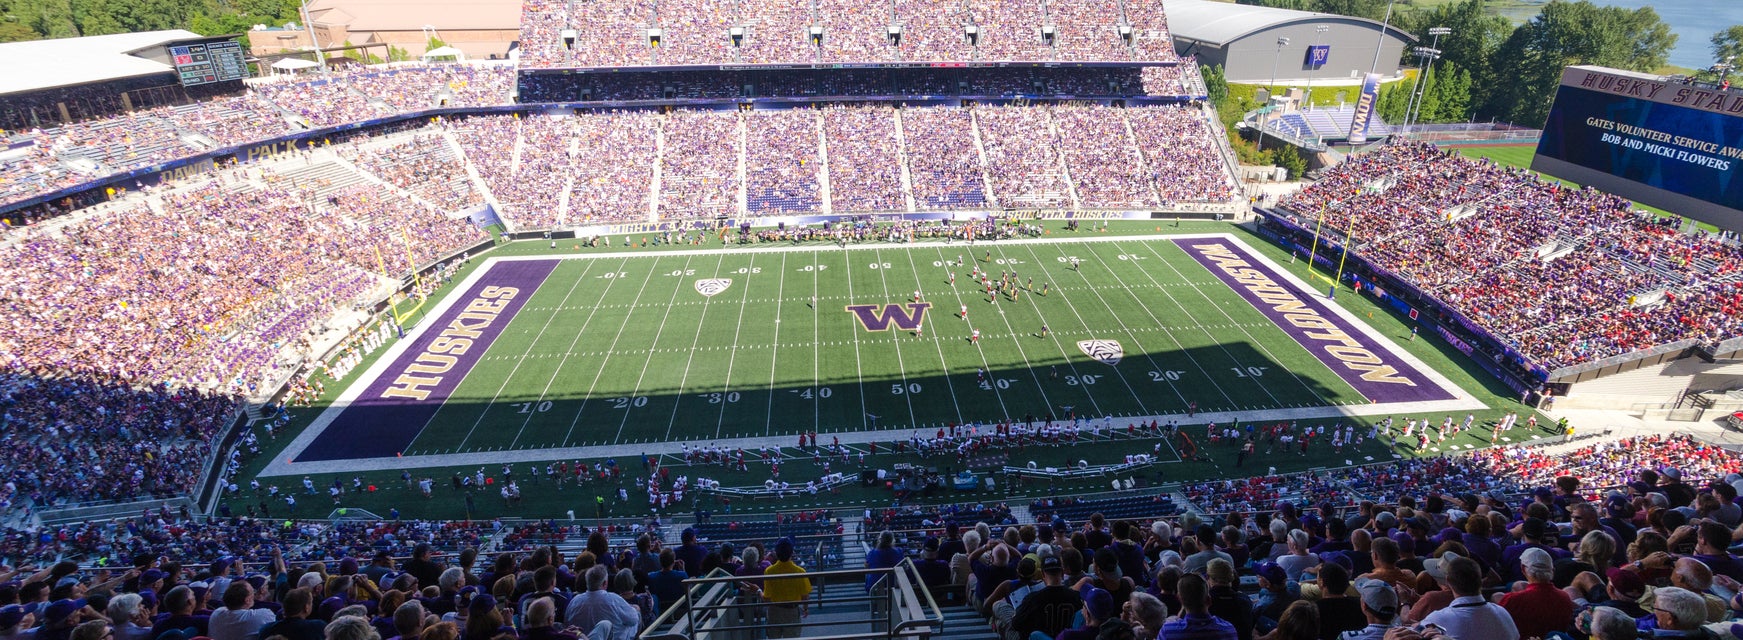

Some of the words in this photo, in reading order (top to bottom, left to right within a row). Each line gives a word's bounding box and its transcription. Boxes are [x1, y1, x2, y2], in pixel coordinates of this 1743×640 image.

[1581, 73, 1665, 99] HUSKY
[1586, 116, 1615, 130] GATES
[1616, 123, 1672, 144] VOLUNTEER
[1672, 135, 1719, 153] SERVICE
[1601, 133, 1622, 144] BOB
[1621, 138, 1644, 150] AND
[1644, 142, 1676, 158] MICKI
[1676, 151, 1731, 171] FLOWERS
[845, 302, 933, 332] W
[1192, 243, 1418, 387] WASHINGTON
[380, 285, 520, 401] HUSKIES
[1149, 370, 1181, 382] 20
[1230, 367, 1264, 378] 10
[979, 378, 1011, 391] 40
[1064, 374, 1097, 386] 30
[800, 387, 833, 400] 40
[891, 383, 922, 396] 50
[613, 395, 649, 409] 20
[708, 391, 740, 404] 30
[516, 400, 553, 414] 10
